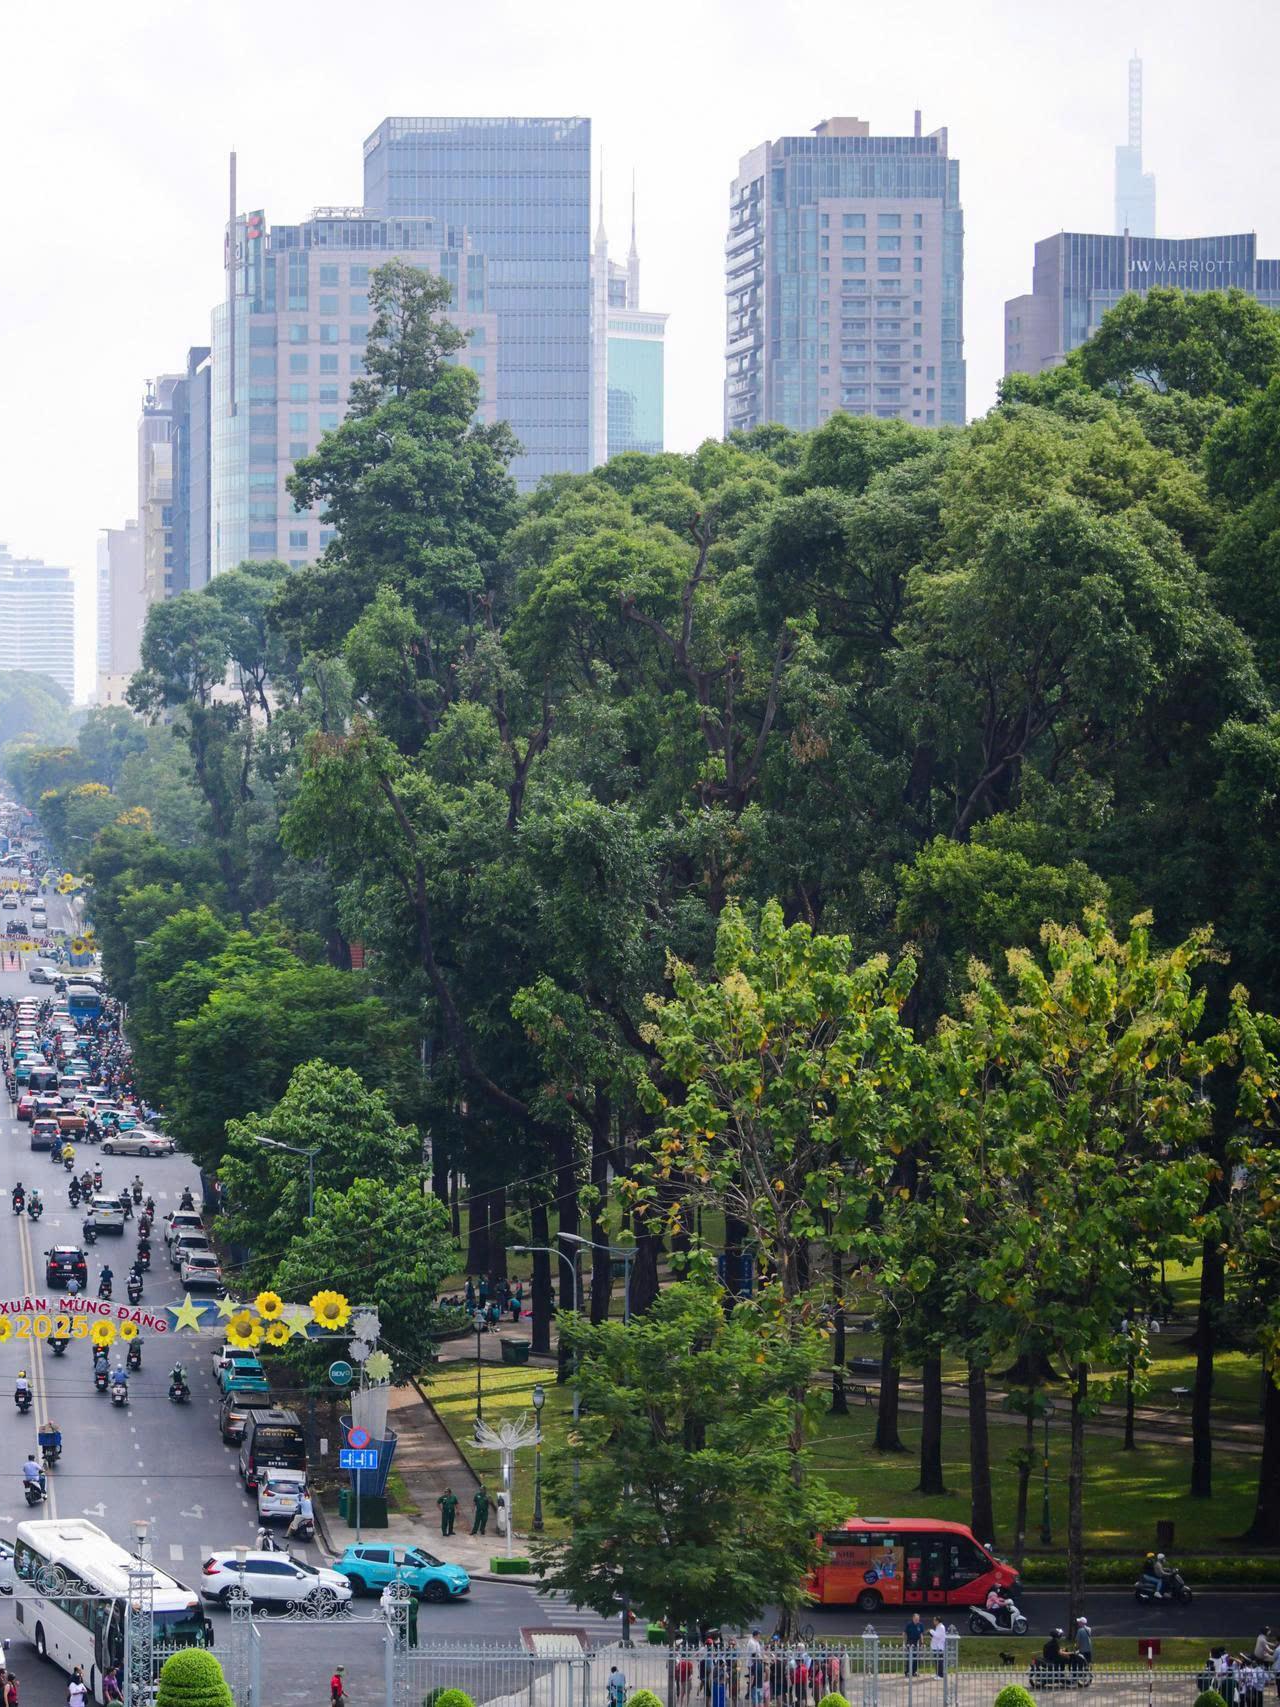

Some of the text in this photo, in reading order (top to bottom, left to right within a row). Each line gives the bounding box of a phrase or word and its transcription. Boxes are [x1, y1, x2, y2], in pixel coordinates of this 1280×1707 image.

[1128, 260, 1234, 273] JW MARRIOTT
[15, 1315, 88, 1339] 2025
